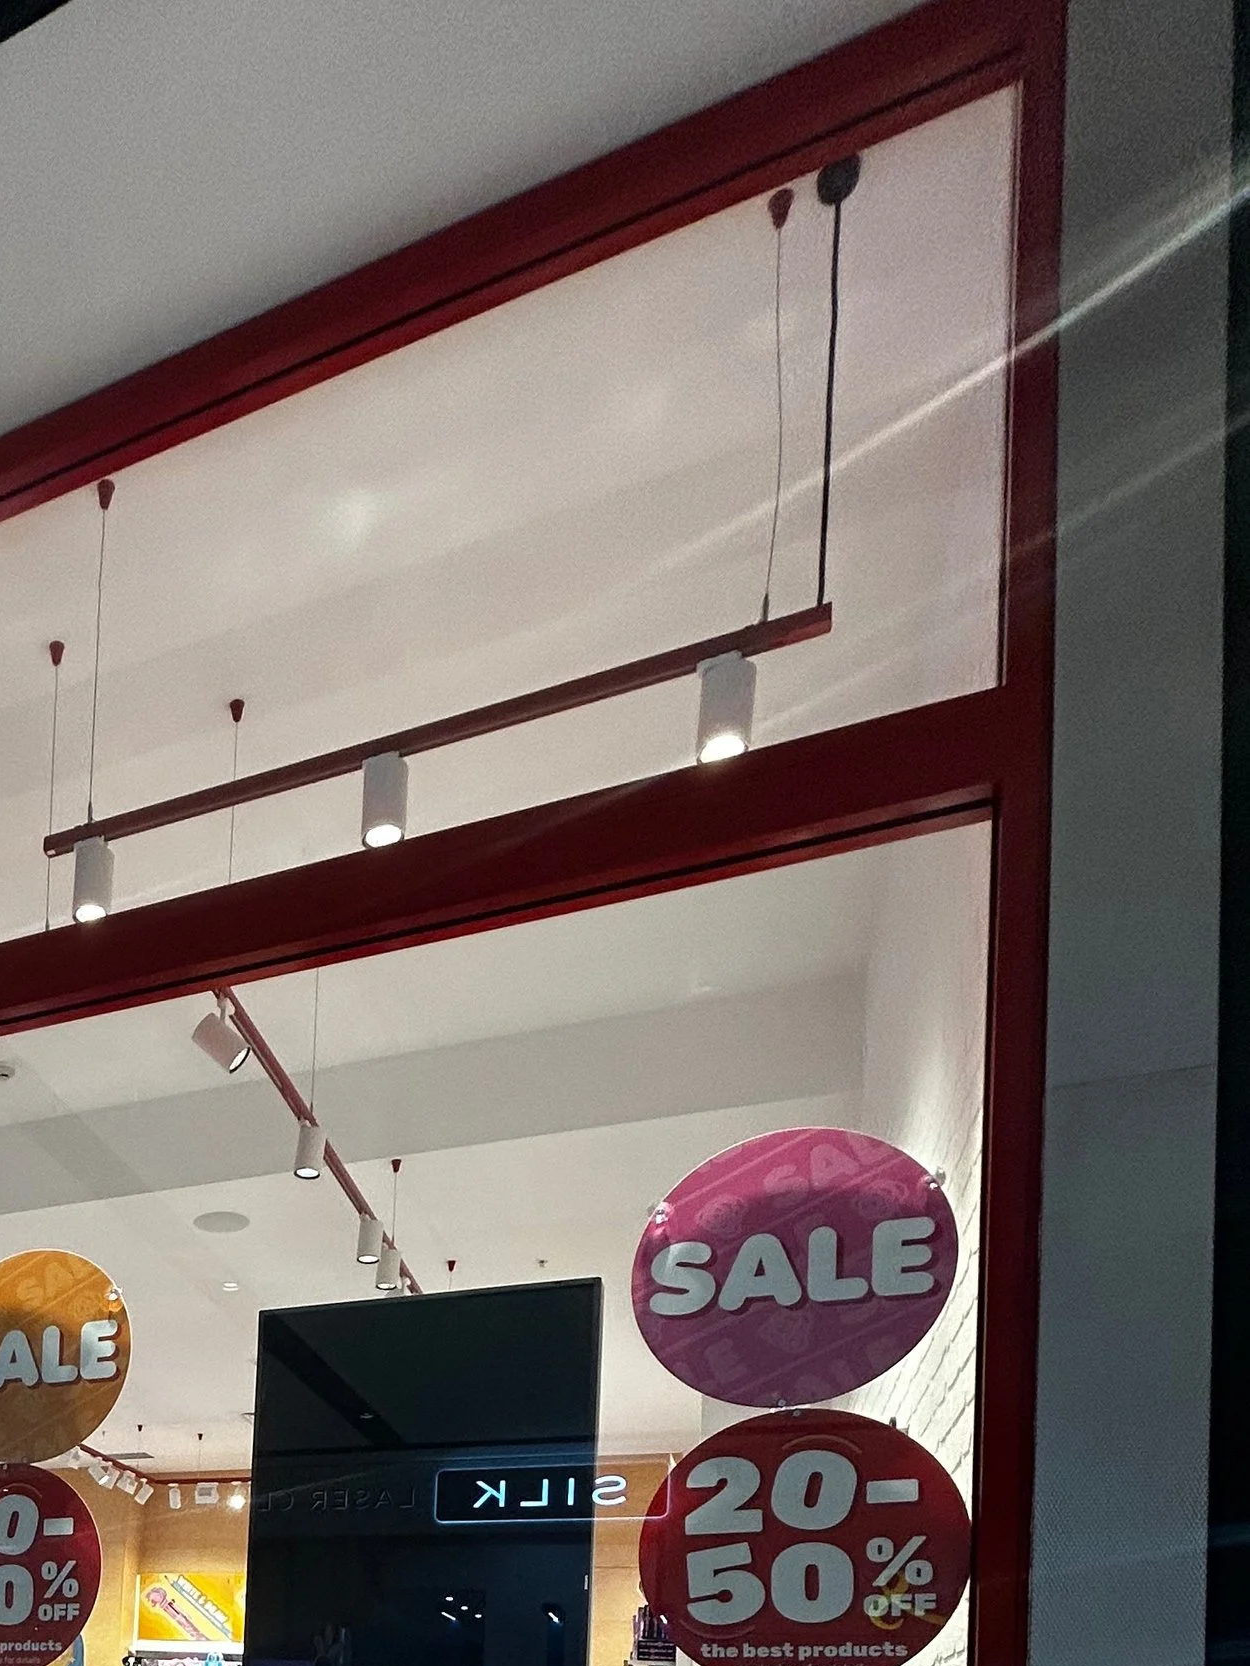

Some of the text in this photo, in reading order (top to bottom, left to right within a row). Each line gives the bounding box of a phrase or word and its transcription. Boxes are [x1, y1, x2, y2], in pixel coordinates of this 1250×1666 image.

[649, 1216, 935, 1316] SALE
[684, 1449, 919, 1535] 20-
[38, 1603, 80, 1621] OFF
[863, 1593, 937, 1617] OFF
[0, 1639, 63, 1653] products
[701, 1641, 908, 1661] the best products
